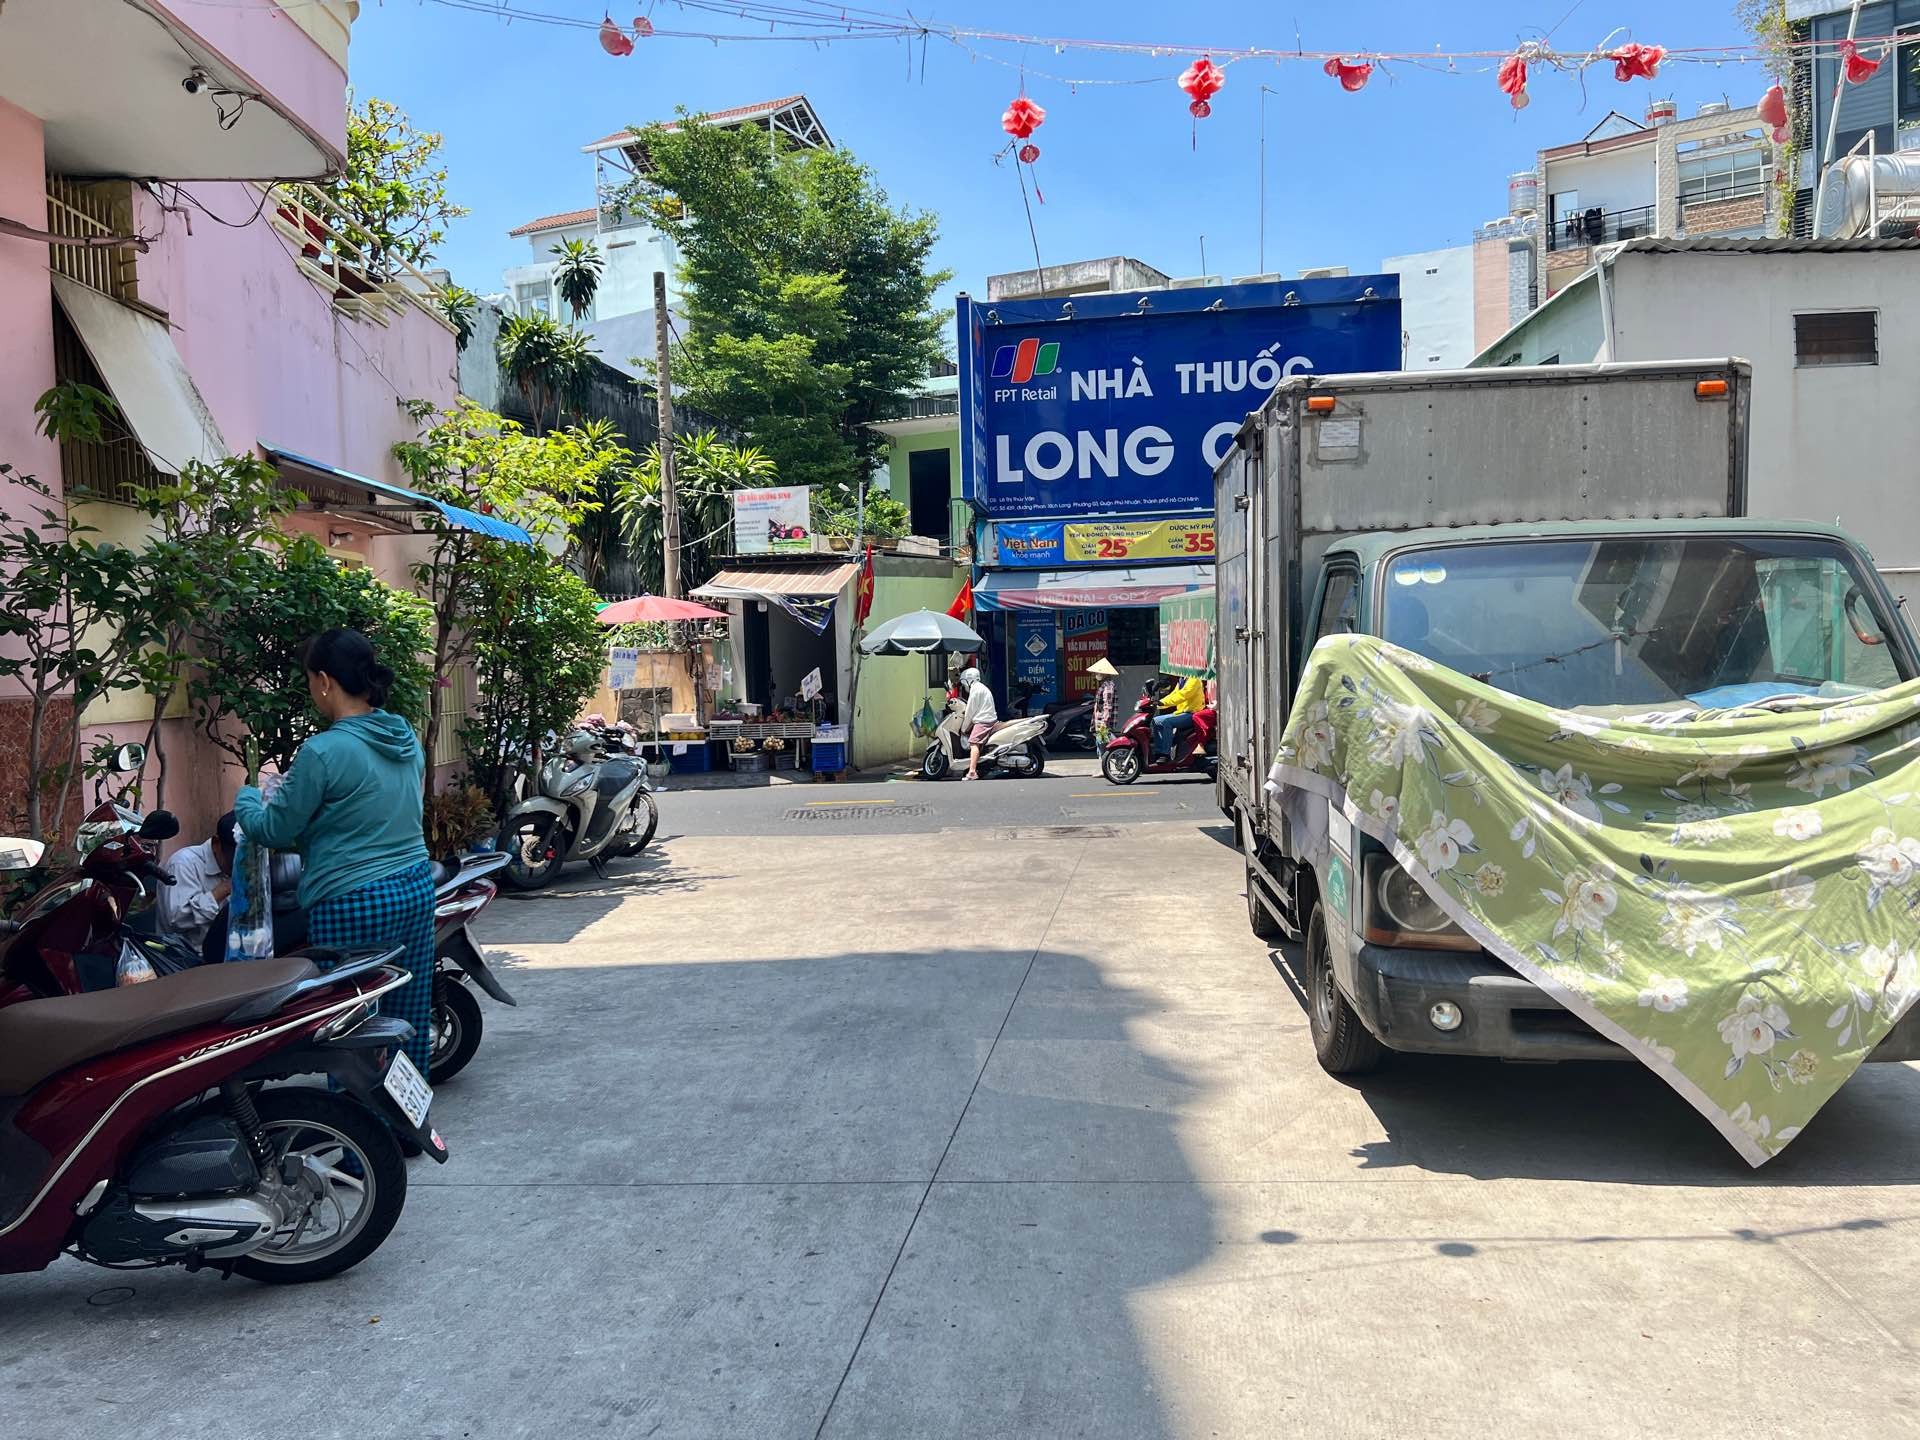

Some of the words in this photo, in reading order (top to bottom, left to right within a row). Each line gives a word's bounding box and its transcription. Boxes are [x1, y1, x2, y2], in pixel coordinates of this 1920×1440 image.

[994, 389, 1017, 403] FPT
[1021, 386, 1057, 401] Retail
[1071, 356, 1153, 401] NHÀ
[996, 425, 1175, 483] LONG
[1184, 532, 1216, 553] 35
